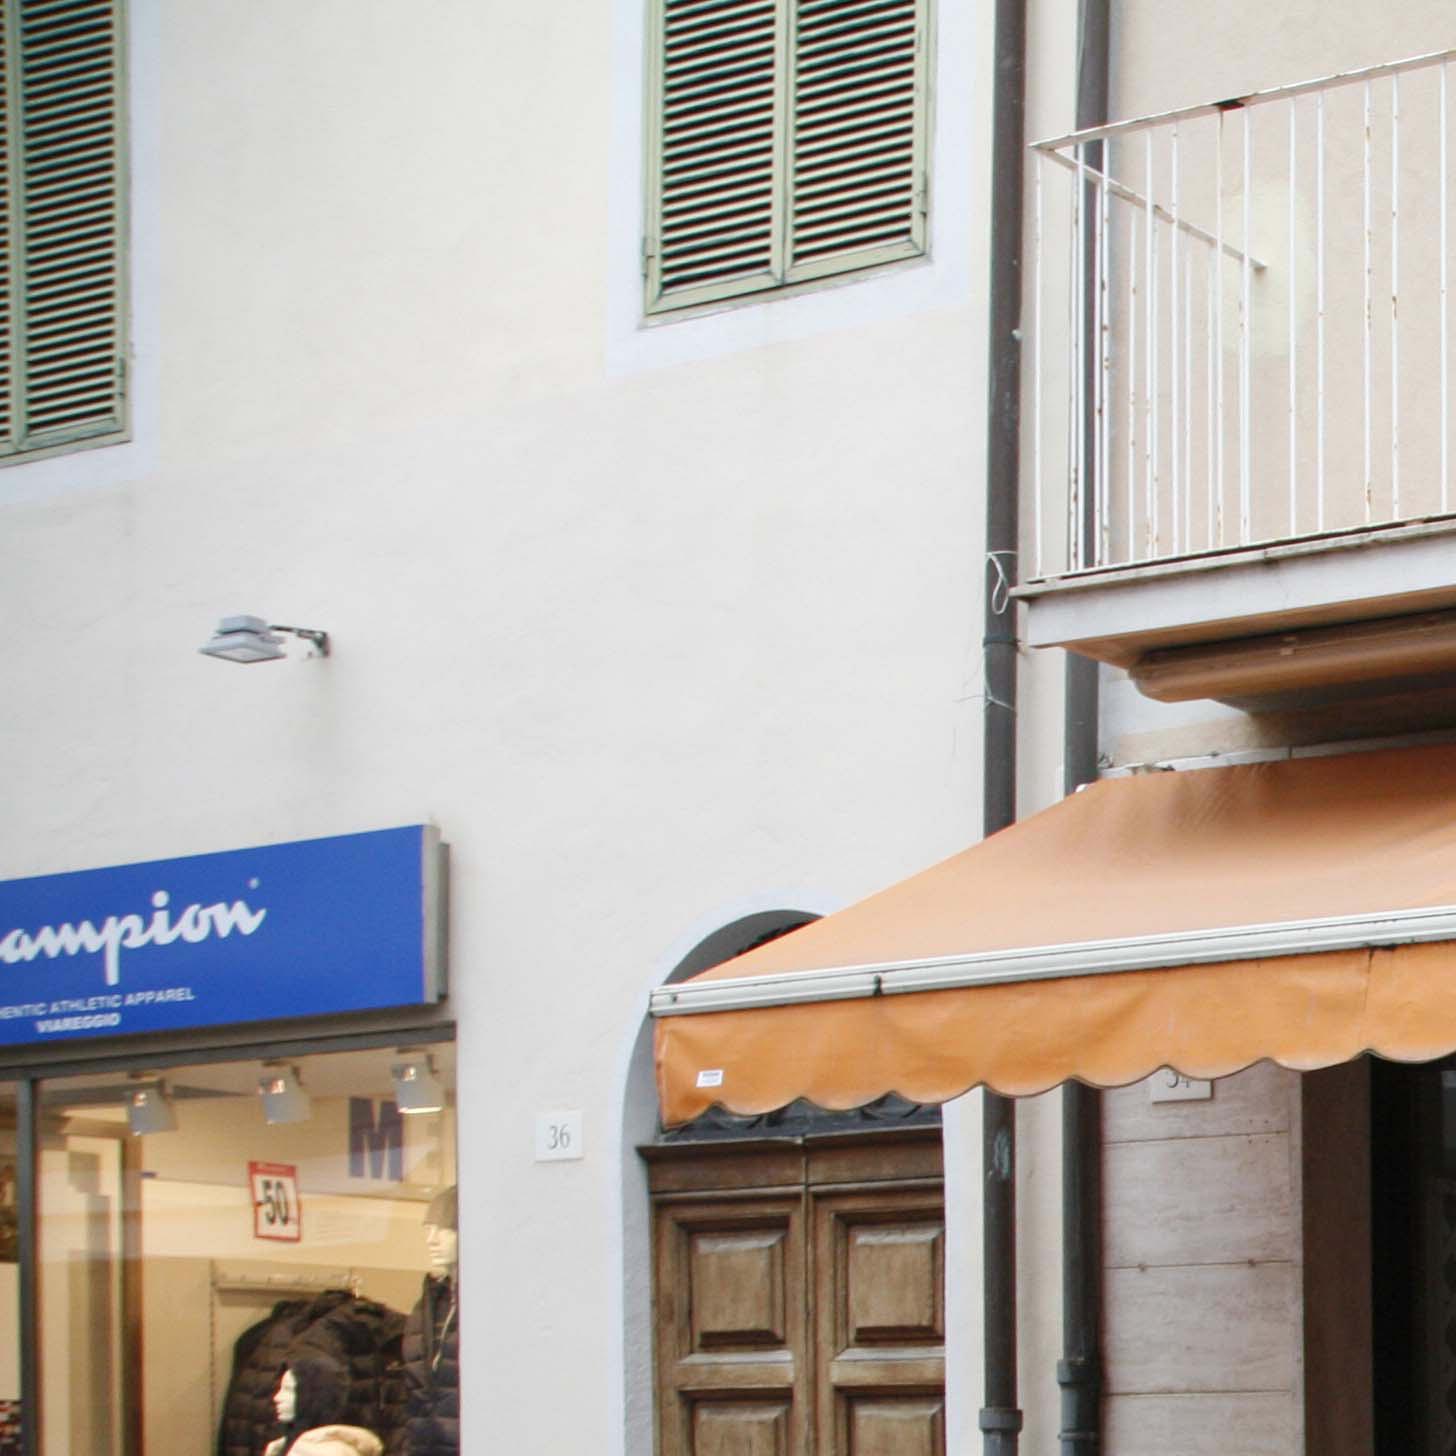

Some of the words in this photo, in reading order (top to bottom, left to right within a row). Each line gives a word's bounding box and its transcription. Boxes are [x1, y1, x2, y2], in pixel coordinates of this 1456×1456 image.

[0, 890, 267, 986] ampion
[49, 993, 123, 1013] ATHLETIC
[124, 987, 195, 1006] APPAREL
[35, 1012, 122, 1034] VIAREGGIO
[548, 1123, 572, 1151] 36
